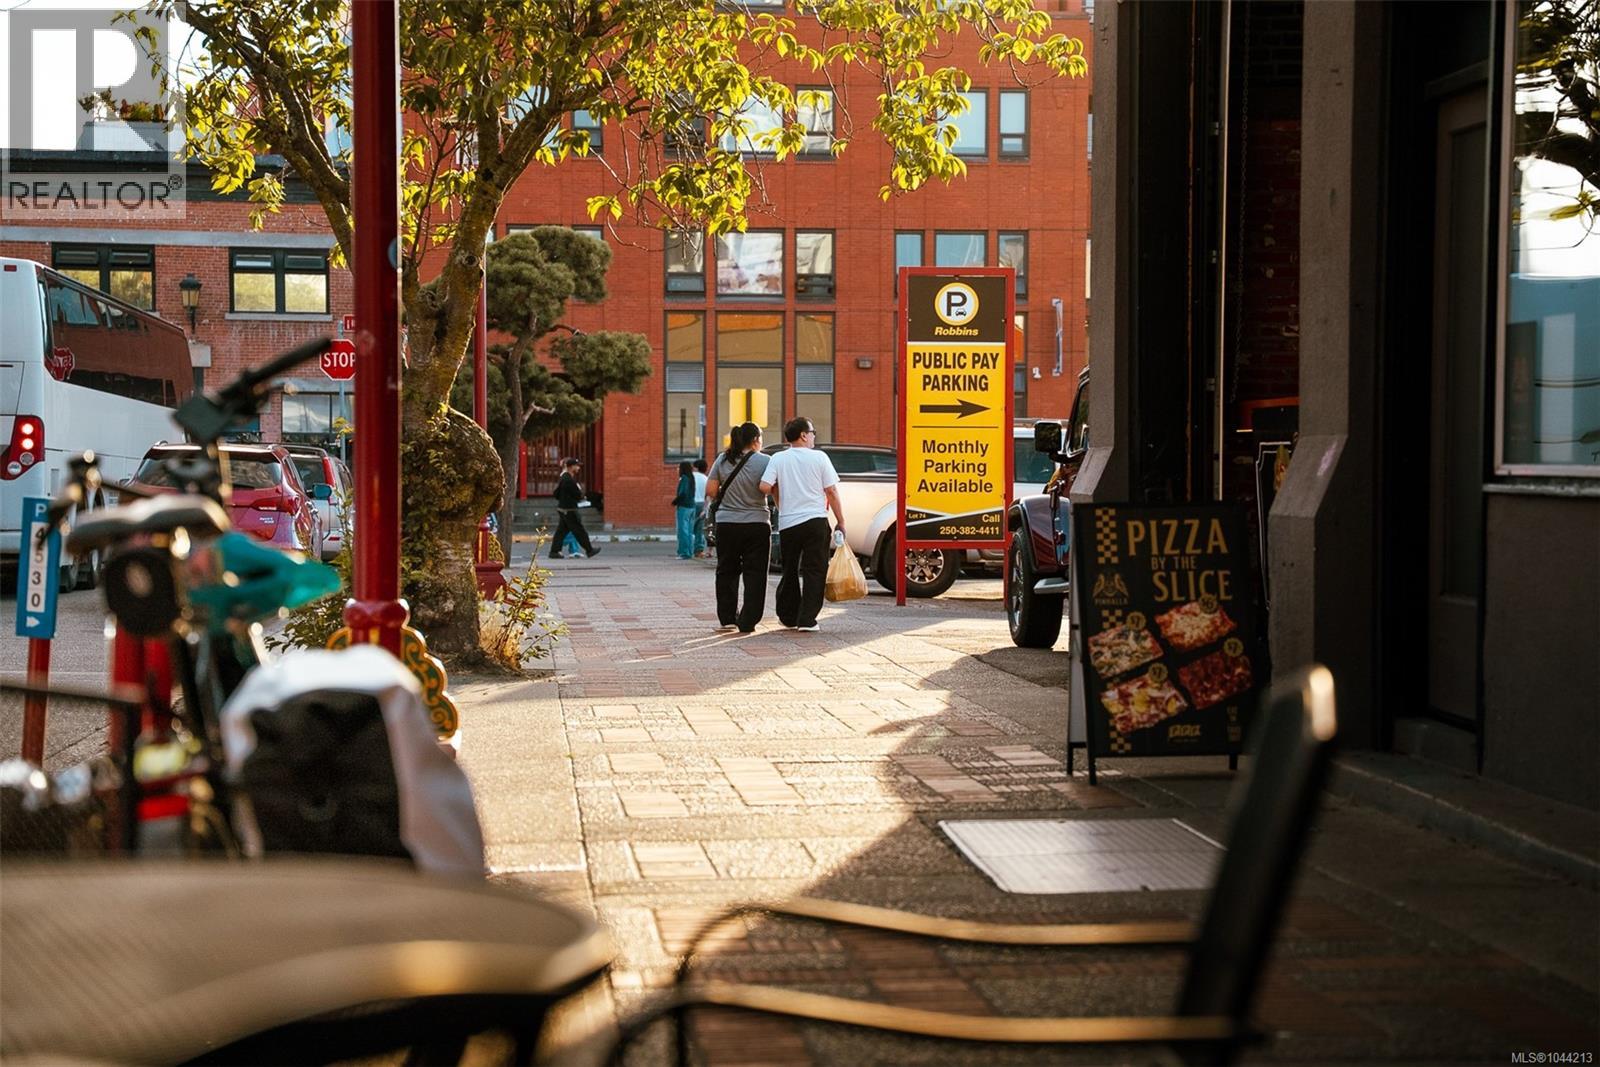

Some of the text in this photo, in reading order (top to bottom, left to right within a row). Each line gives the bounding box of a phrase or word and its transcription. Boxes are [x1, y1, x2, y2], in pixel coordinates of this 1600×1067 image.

[946, 291, 968, 317] P
[934, 326, 979, 336] Robbins
[323, 352, 355, 368] STOP
[912, 352, 999, 369] PUBLIC PAY
[922, 374, 989, 392] PARKING
[922, 440, 989, 457] Monthly
[924, 459, 987, 476] Parking
[917, 479, 993, 493] Available
[35, 503, 47, 517] P
[982, 514, 1000, 523] Call
[940, 526, 1000, 535] 250-382-4411
[1127, 518, 1229, 557] PIZZA
[1151, 556, 1197, 570] BY THE
[1152, 570, 1233, 602] SLICE
